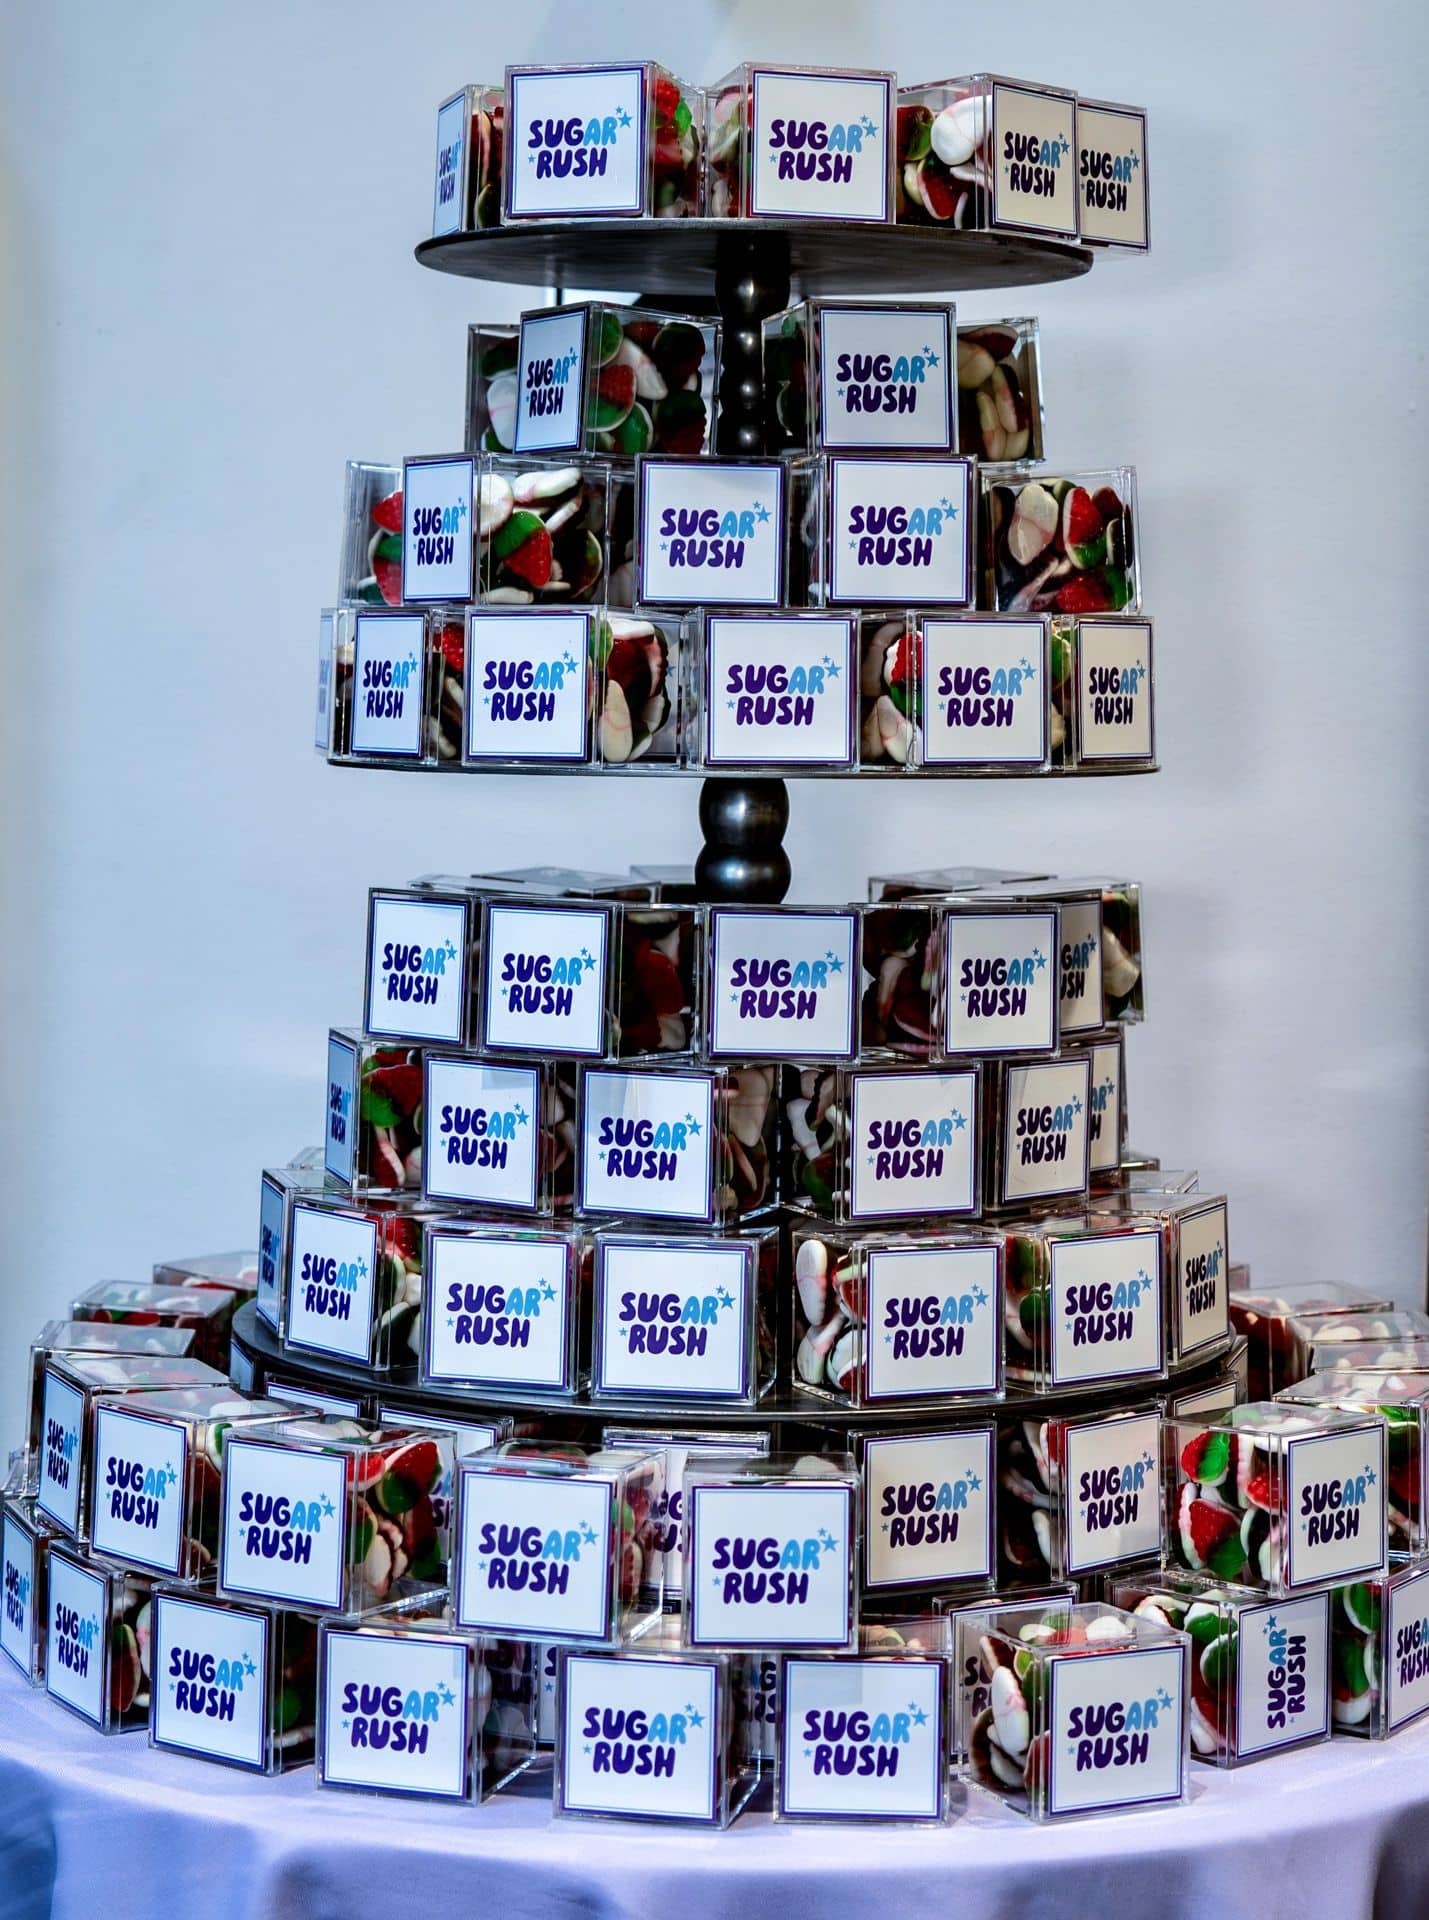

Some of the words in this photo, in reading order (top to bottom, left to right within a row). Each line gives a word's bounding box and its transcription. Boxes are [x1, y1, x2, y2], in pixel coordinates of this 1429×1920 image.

[528, 117, 617, 148] SUGAR
[769, 119, 863, 153] SUGAR
[537, 148, 607, 179] RUSH
[1004, 131, 1060, 168] SUGAR
[1080, 149, 1131, 183] SUGAR
[779, 151, 852, 183] RUSH
[1010, 163, 1055, 197] RUSH
[1086, 179, 1127, 211] RUSH
[526, 356, 570, 389] SUGAR
[836, 354, 925, 384] SUGAR
[529, 386, 563, 415] RUSH
[846, 384, 916, 414] RUSH
[413, 506, 459, 536] SUGAR
[660, 508, 755, 539] SUGAR
[848, 506, 942, 536] SUGAR
[417, 536, 454, 566] RUSH
[669, 539, 744, 568] RUSH
[858, 536, 932, 567] RUSH
[363, 660, 410, 688] SUGAR
[483, 661, 564, 691] SUGAR
[726, 665, 824, 695] SUGAR
[938, 667, 1022, 696] SUGAR
[1089, 667, 1138, 695] SUGAR
[367, 690, 403, 719] RUSH
[491, 692, 555, 722] RUSH
[737, 696, 814, 726] RUSH
[947, 697, 1013, 727] RUSH
[1095, 696, 1133, 725] RUSH
[382, 943, 446, 975] SUGAR
[501, 953, 582, 986] SUGAR
[960, 958, 1035, 987] SUGAR
[1062, 943, 1089, 970] GAR
[388, 973, 438, 1004] RUSH
[731, 958, 828, 989] SUGAR
[509, 984, 573, 1016] RUSH
[740, 989, 817, 1019] RUSH
[968, 987, 1026, 1018] RUSH
[440, 1105, 516, 1140] SUGAR
[599, 1117, 687, 1151] SUGAR
[868, 1119, 953, 1149] SUGAR
[1016, 1104, 1073, 1136] SUGAR
[448, 1136, 507, 1169] RUSH
[607, 1148, 677, 1181] RUSH
[876, 1149, 943, 1180] RUSH
[1021, 1134, 1066, 1165] RUSH
[301, 1253, 358, 1293] SUGAR
[1186, 1253, 1218, 1288] SUGAR
[306, 1284, 350, 1320] RUSH
[447, 1283, 541, 1317] SUGAR
[619, 1292, 718, 1325] SUGAR
[884, 1295, 973, 1328] SUGAR
[1065, 1280, 1140, 1315] SUGAR
[1190, 1280, 1215, 1316] RUSH
[455, 1315, 530, 1347] RUSH
[629, 1324, 707, 1356] RUSH
[893, 1327, 964, 1360] RUSH
[1073, 1311, 1133, 1346] RUSH
[47, 1418, 73, 1461] SUGAR
[48, 1449, 69, 1489] RUSH
[106, 1457, 167, 1500] SUGAR
[1079, 1462, 1144, 1502] SUGAR
[111, 1489, 159, 1529] RUSH
[239, 1492, 321, 1533] SUGAR
[881, 1481, 967, 1516] SUGAR
[1087, 1493, 1138, 1532] RUSH
[1301, 1476, 1366, 1516] SUGAR
[479, 1523, 581, 1562] SUGAR
[890, 1512, 958, 1548] RUSH
[1308, 1508, 1359, 1547] RUSH
[247, 1525, 312, 1564] RUSH
[712, 1538, 820, 1570] SUGAR
[488, 1558, 569, 1594] RUSH
[724, 1572, 808, 1604] RUSH
[7, 1592, 23, 1632] RUSH
[55, 1603, 94, 1649] SUGAR
[1396, 1617, 1429, 1659] SUGA
[59, 1635, 88, 1678] RUSH
[169, 1647, 244, 1691] SUGAR
[1267, 1629, 1287, 1729] SUGAR
[1287, 1635, 1306, 1713] RUSH
[176, 1681, 235, 1721] RUSH
[342, 1683, 439, 1722] SUGAR
[583, 1707, 687, 1744] SUGAR
[803, 1710, 910, 1744] SUGAR
[1068, 1699, 1158, 1738] SUGAR
[351, 1717, 428, 1754] RUSH
[1077, 1733, 1148, 1771] RUSH
[593, 1742, 675, 1777] RUSH
[814, 1744, 898, 1777] RUSH
